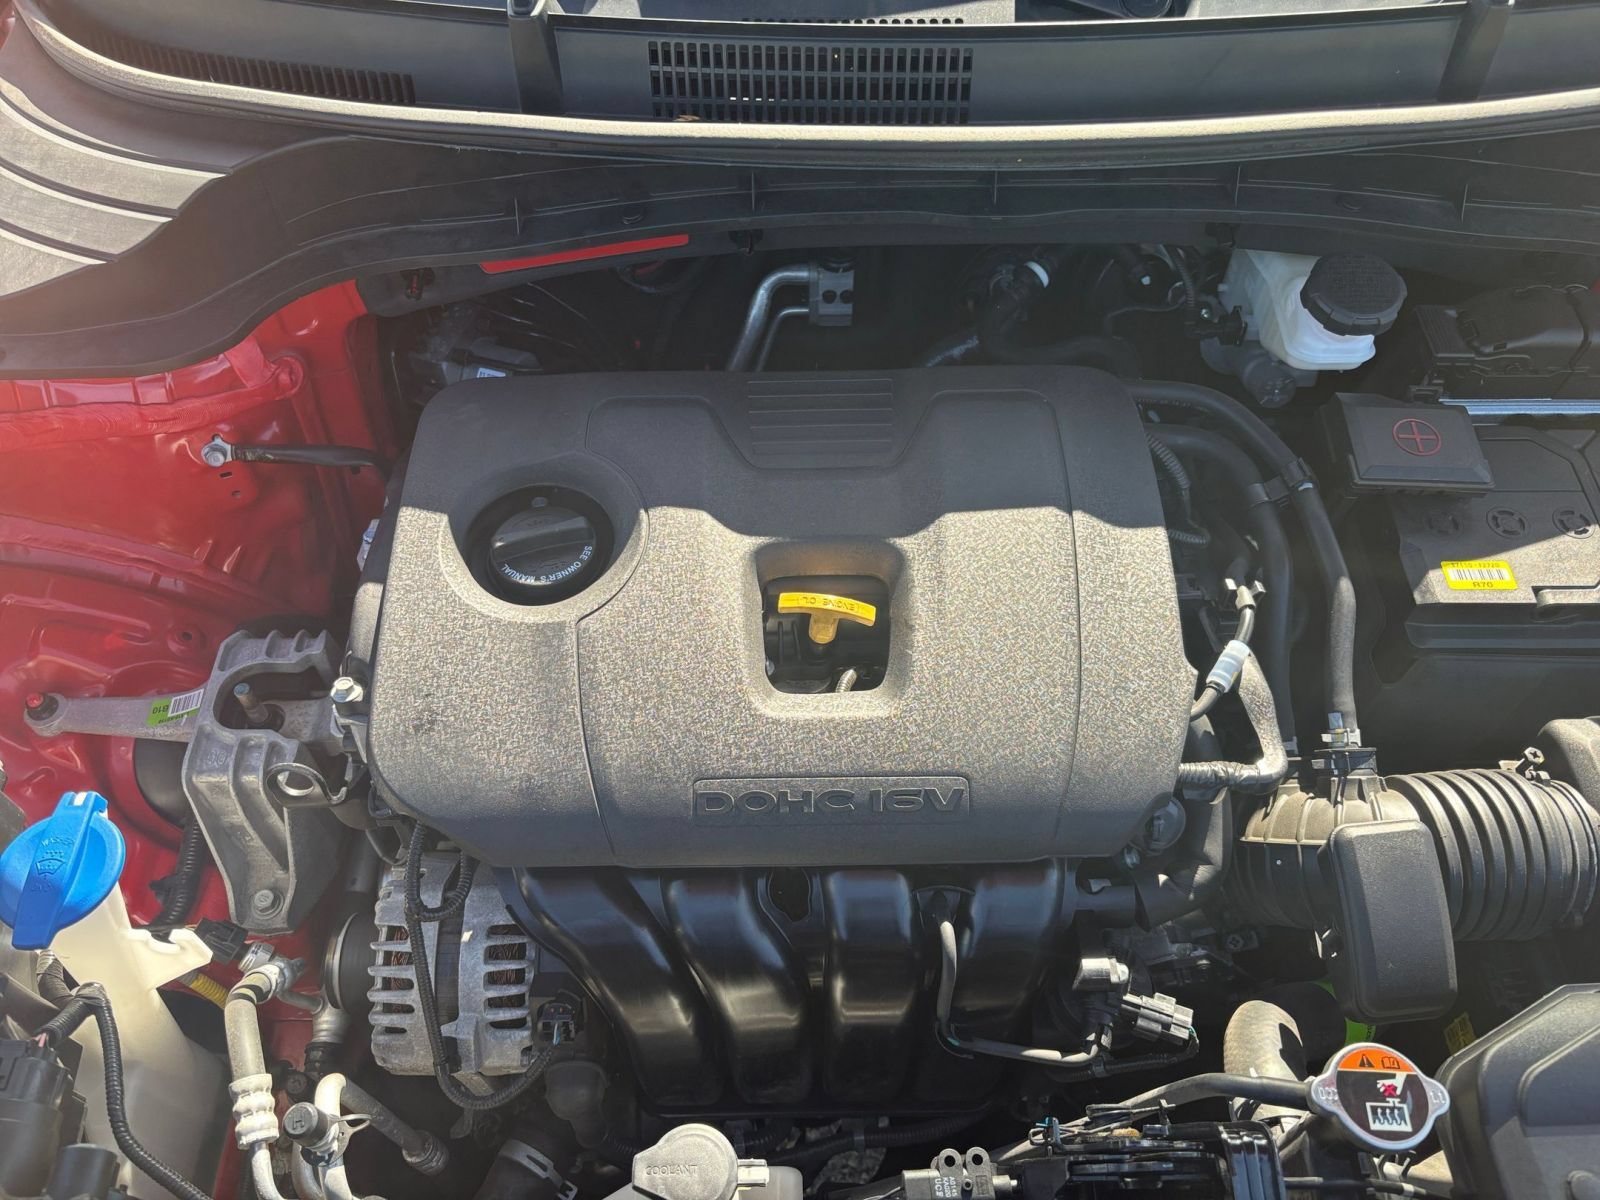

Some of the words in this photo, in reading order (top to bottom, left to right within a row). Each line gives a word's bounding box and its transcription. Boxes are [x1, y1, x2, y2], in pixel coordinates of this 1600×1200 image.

[579, 545, 593, 561] SEE
[500, 563, 536, 583] MANUAL
[540, 561, 582, 583] OWNER'S
[695, 789, 855, 813] DOHC
[869, 787, 965, 813] 16V
[645, 1164, 698, 1176] COOLANT
